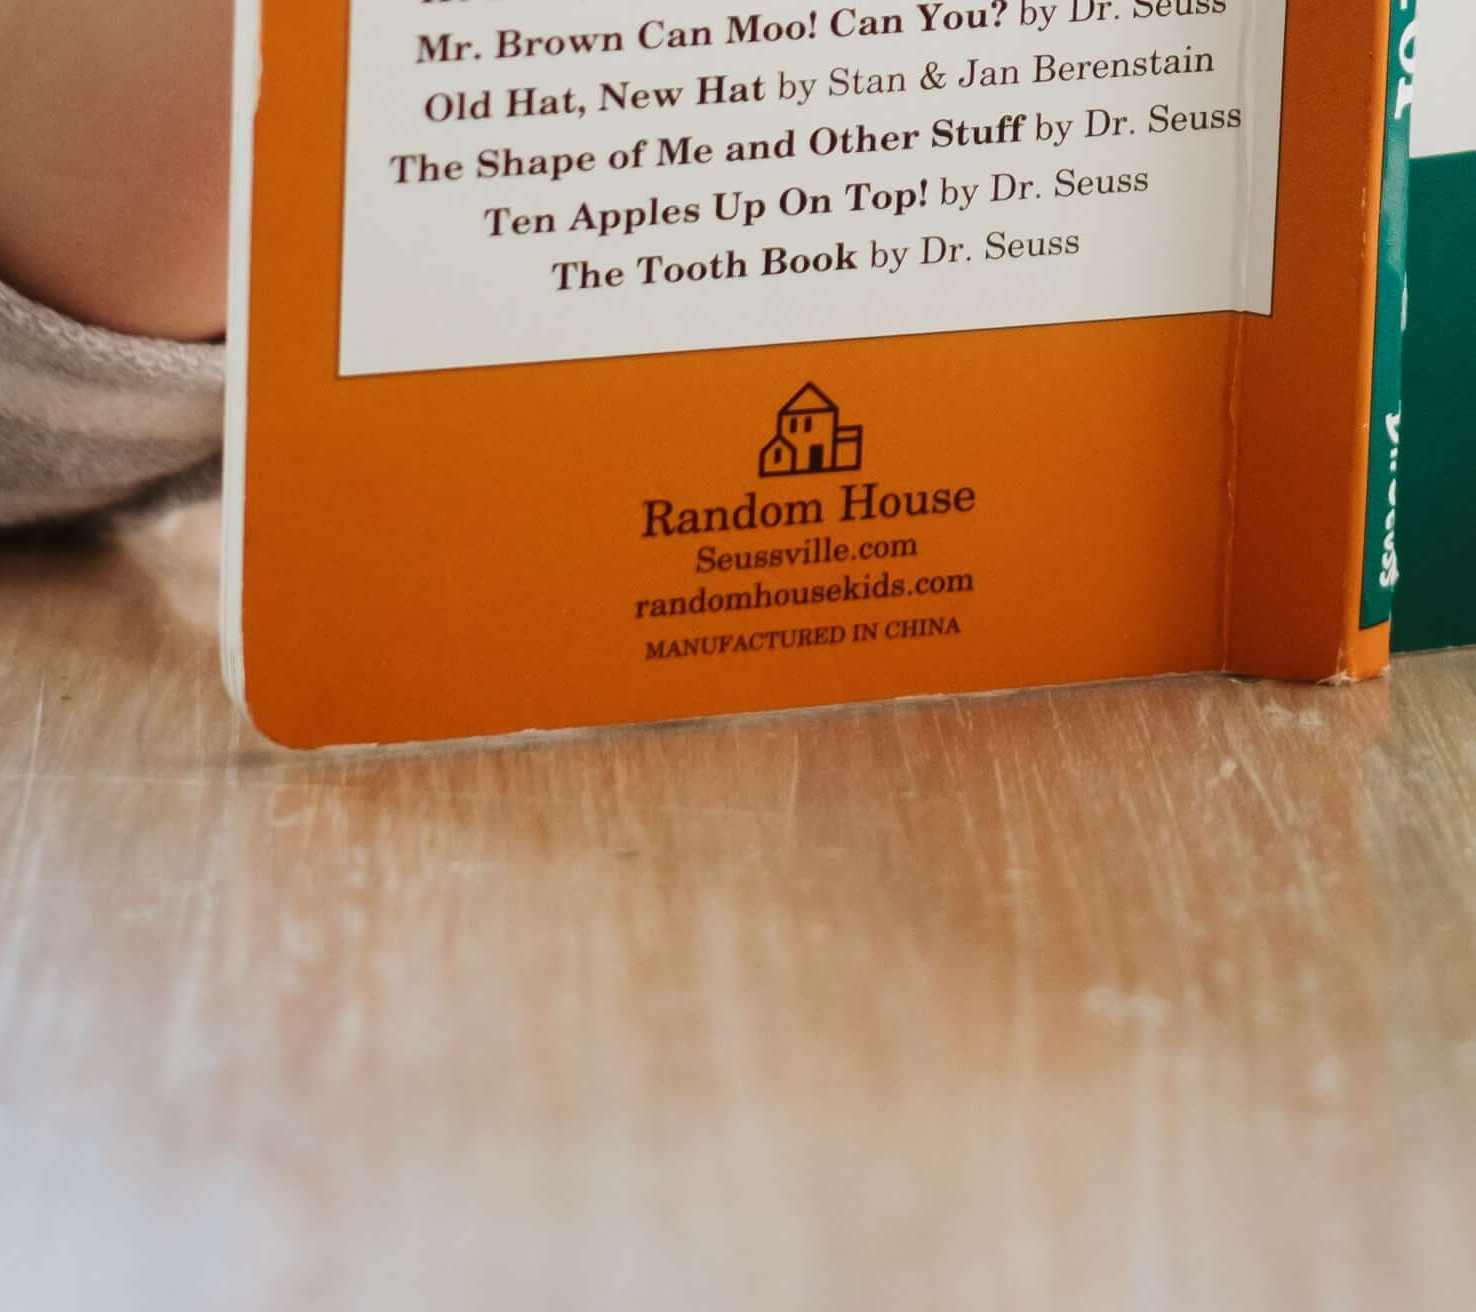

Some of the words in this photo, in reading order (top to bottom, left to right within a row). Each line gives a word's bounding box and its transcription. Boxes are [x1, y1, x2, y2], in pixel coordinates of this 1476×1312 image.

[417, 34, 481, 63] Mr.
[496, 30, 623, 58] Brown
[638, 21, 712, 49] Can
[726, 11, 816, 44] Moo!
[830, 8, 903, 37] Can
[916, 0, 1007, 31] You?
[425, 90, 491, 122] Old
[506, 88, 585, 118] Hat,
[599, 82, 683, 111] New
[697, 75, 765, 104] Hat
[779, 71, 816, 105] by
[829, 68, 905, 96] Stan
[920, 62, 946, 90] &
[959, 59, 1019, 88] Jan
[1032, 46, 1214, 83] Berenstain
[390, 154, 463, 183] The
[477, 148, 595, 181] Shape
[609, 139, 648, 169] of
[657, 137, 712, 166] Me
[726, 130, 795, 162] and
[810, 125, 919, 155] Other
[932, 114, 1027, 147] Stuff
[1036, 113, 1072, 147] by
[1085, 109, 1134, 137] Dr.
[1149, 105, 1241, 133] Seuss
[484, 208, 555, 236] Ten
[569, 197, 700, 236] Apples
[714, 192, 765, 226] Up
[779, 187, 831, 216] On
[845, 179, 927, 216] Top!
[941, 177, 979, 211] by
[990, 174, 1040, 201] Dr.
[1055, 169, 1148, 197] Seuss
[552, 261, 623, 290] The
[637, 250, 747, 284] Tooth
[761, 243, 857, 276] Book
[871, 240, 908, 274] by
[921, 236, 971, 264] Dr.
[986, 232, 1079, 259] Seuss
[642, 492, 824, 538] Random
[840, 483, 975, 522] House
[696, 536, 918, 573] Seussville.com
[636, 571, 973, 619] randomhousekids.com
[645, 626, 846, 660] MANUFACTURED
[852, 622, 879, 642] IN
[885, 616, 961, 640] CHINA
